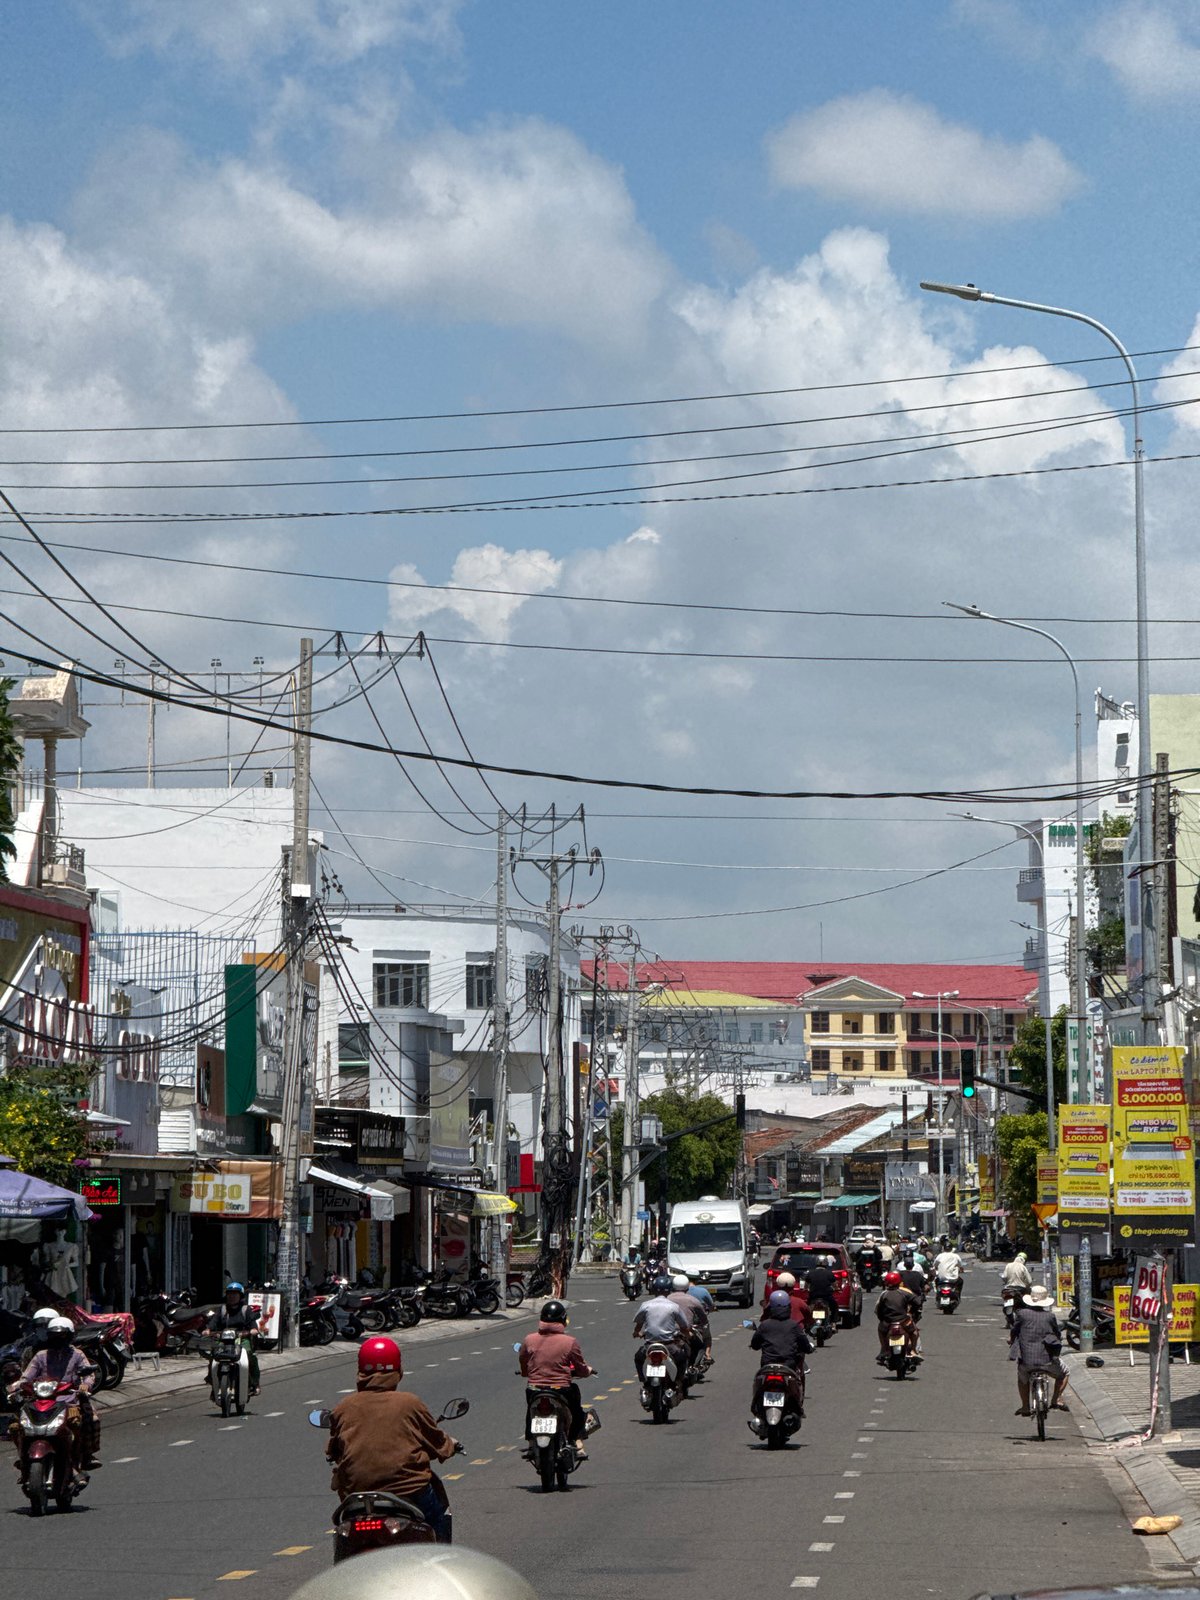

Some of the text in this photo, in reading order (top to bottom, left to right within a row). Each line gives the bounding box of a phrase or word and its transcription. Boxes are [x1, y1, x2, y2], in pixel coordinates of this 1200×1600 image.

[1130, 1067, 1158, 1075] LAPTOP
[1121, 1092, 1182, 1103] 3.000.000
[180, 1183, 242, 1201] SU BO
[322, 1197, 351, 1207] MEN
[1134, 1227, 1188, 1237] thegioididong
[1175, 1318, 1196, 1330] MÁY
